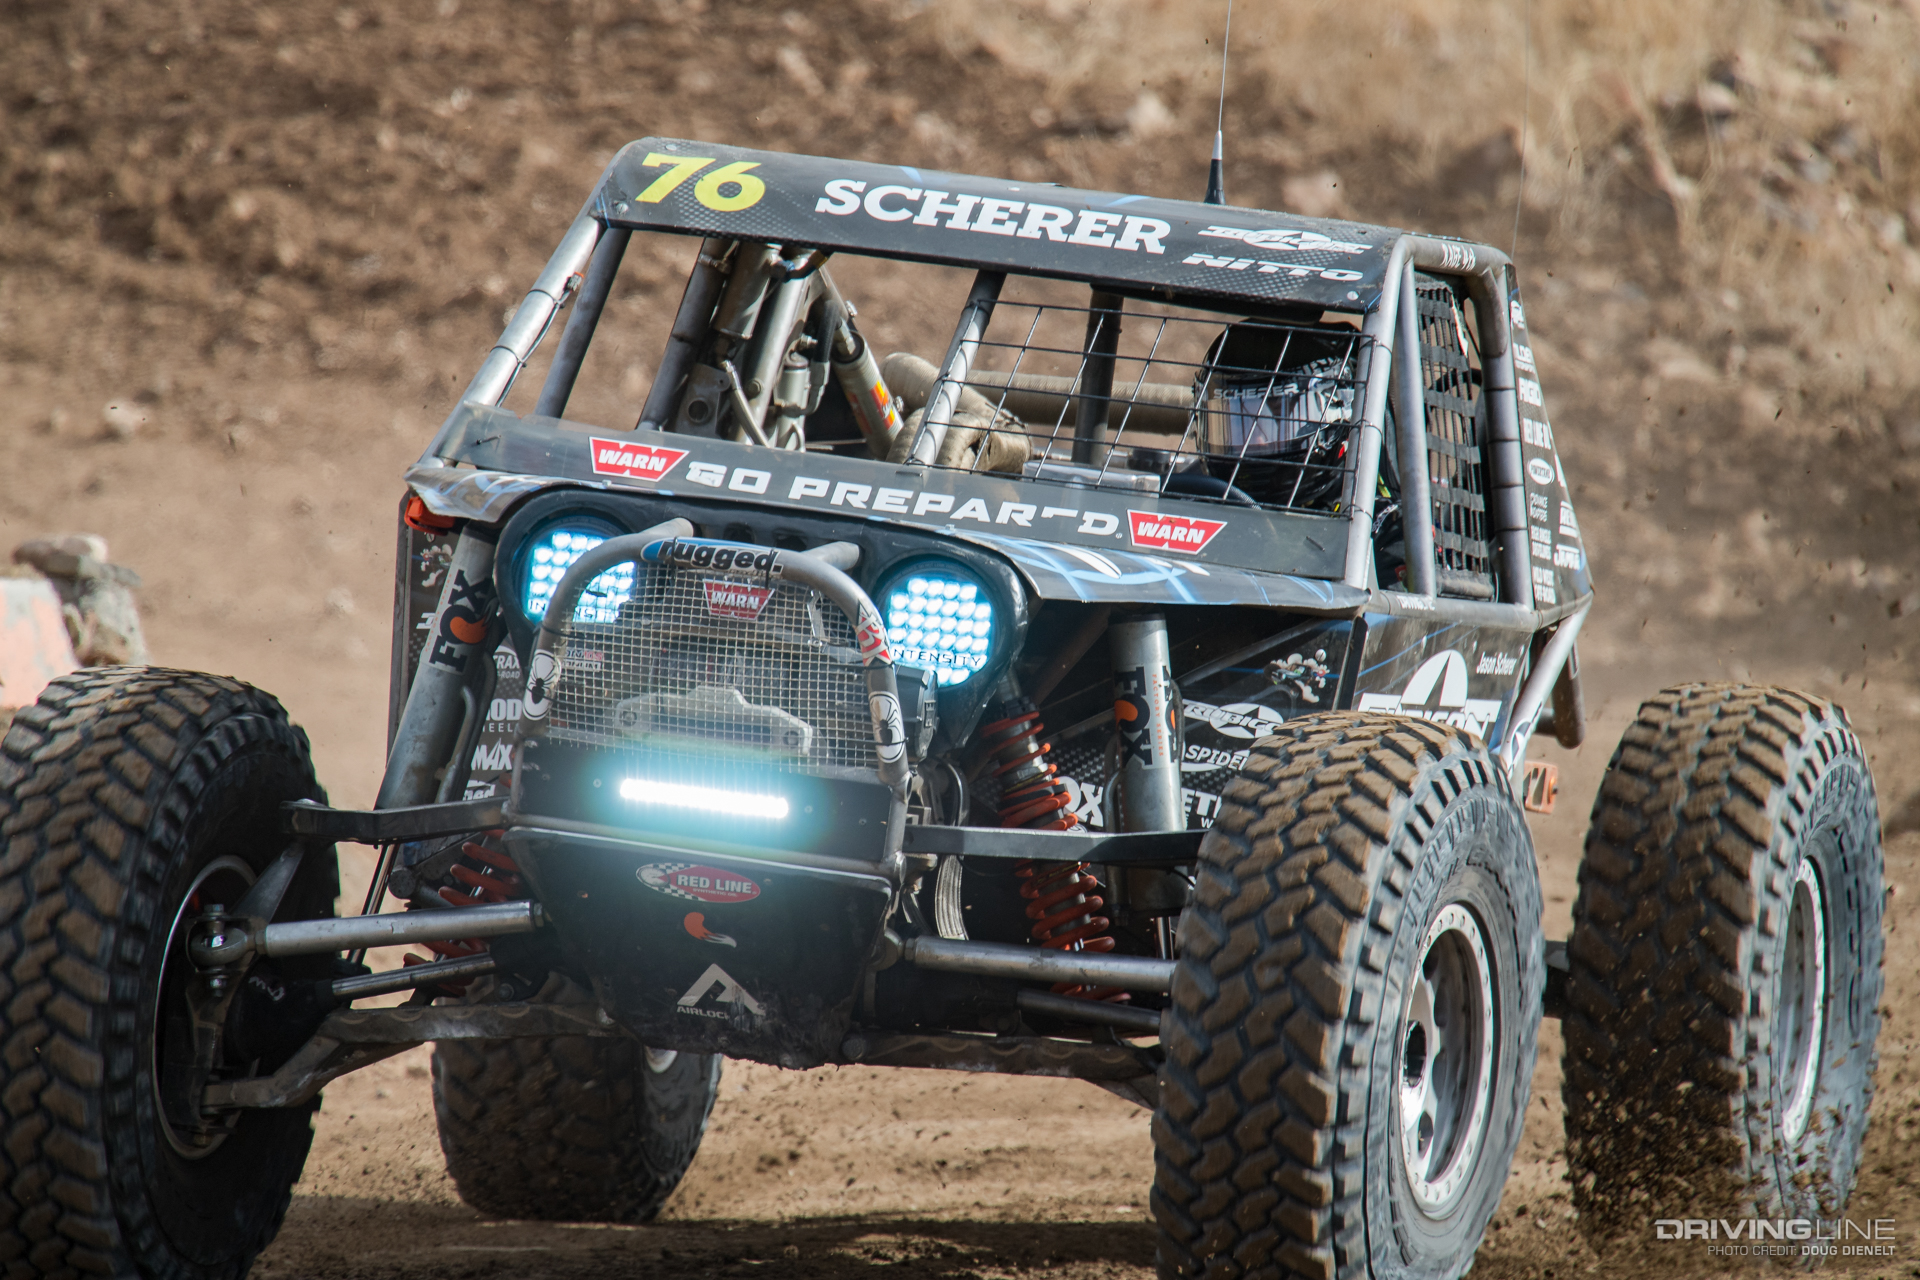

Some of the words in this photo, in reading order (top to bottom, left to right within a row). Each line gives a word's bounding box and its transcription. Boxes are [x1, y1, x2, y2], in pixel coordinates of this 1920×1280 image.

[634, 152, 766, 212] 76
[814, 178, 1172, 255] SCHERER
[1182, 253, 1363, 281] NITTO
[598, 449, 667, 472] WARN
[788, 476, 1119, 536] PREPARD
[1137, 521, 1205, 544] WARN
[429, 568, 500, 676] FOX
[711, 591, 760, 609] WARN
[893, 648, 982, 667] NTENSITY
[1113, 666, 1153, 767] FOX
[1152, 673, 1160, 718] FACTORY
[1156, 723, 1164, 757] SERIES
[677, 874, 710, 889] RED
[715, 879, 752, 894] LINE
